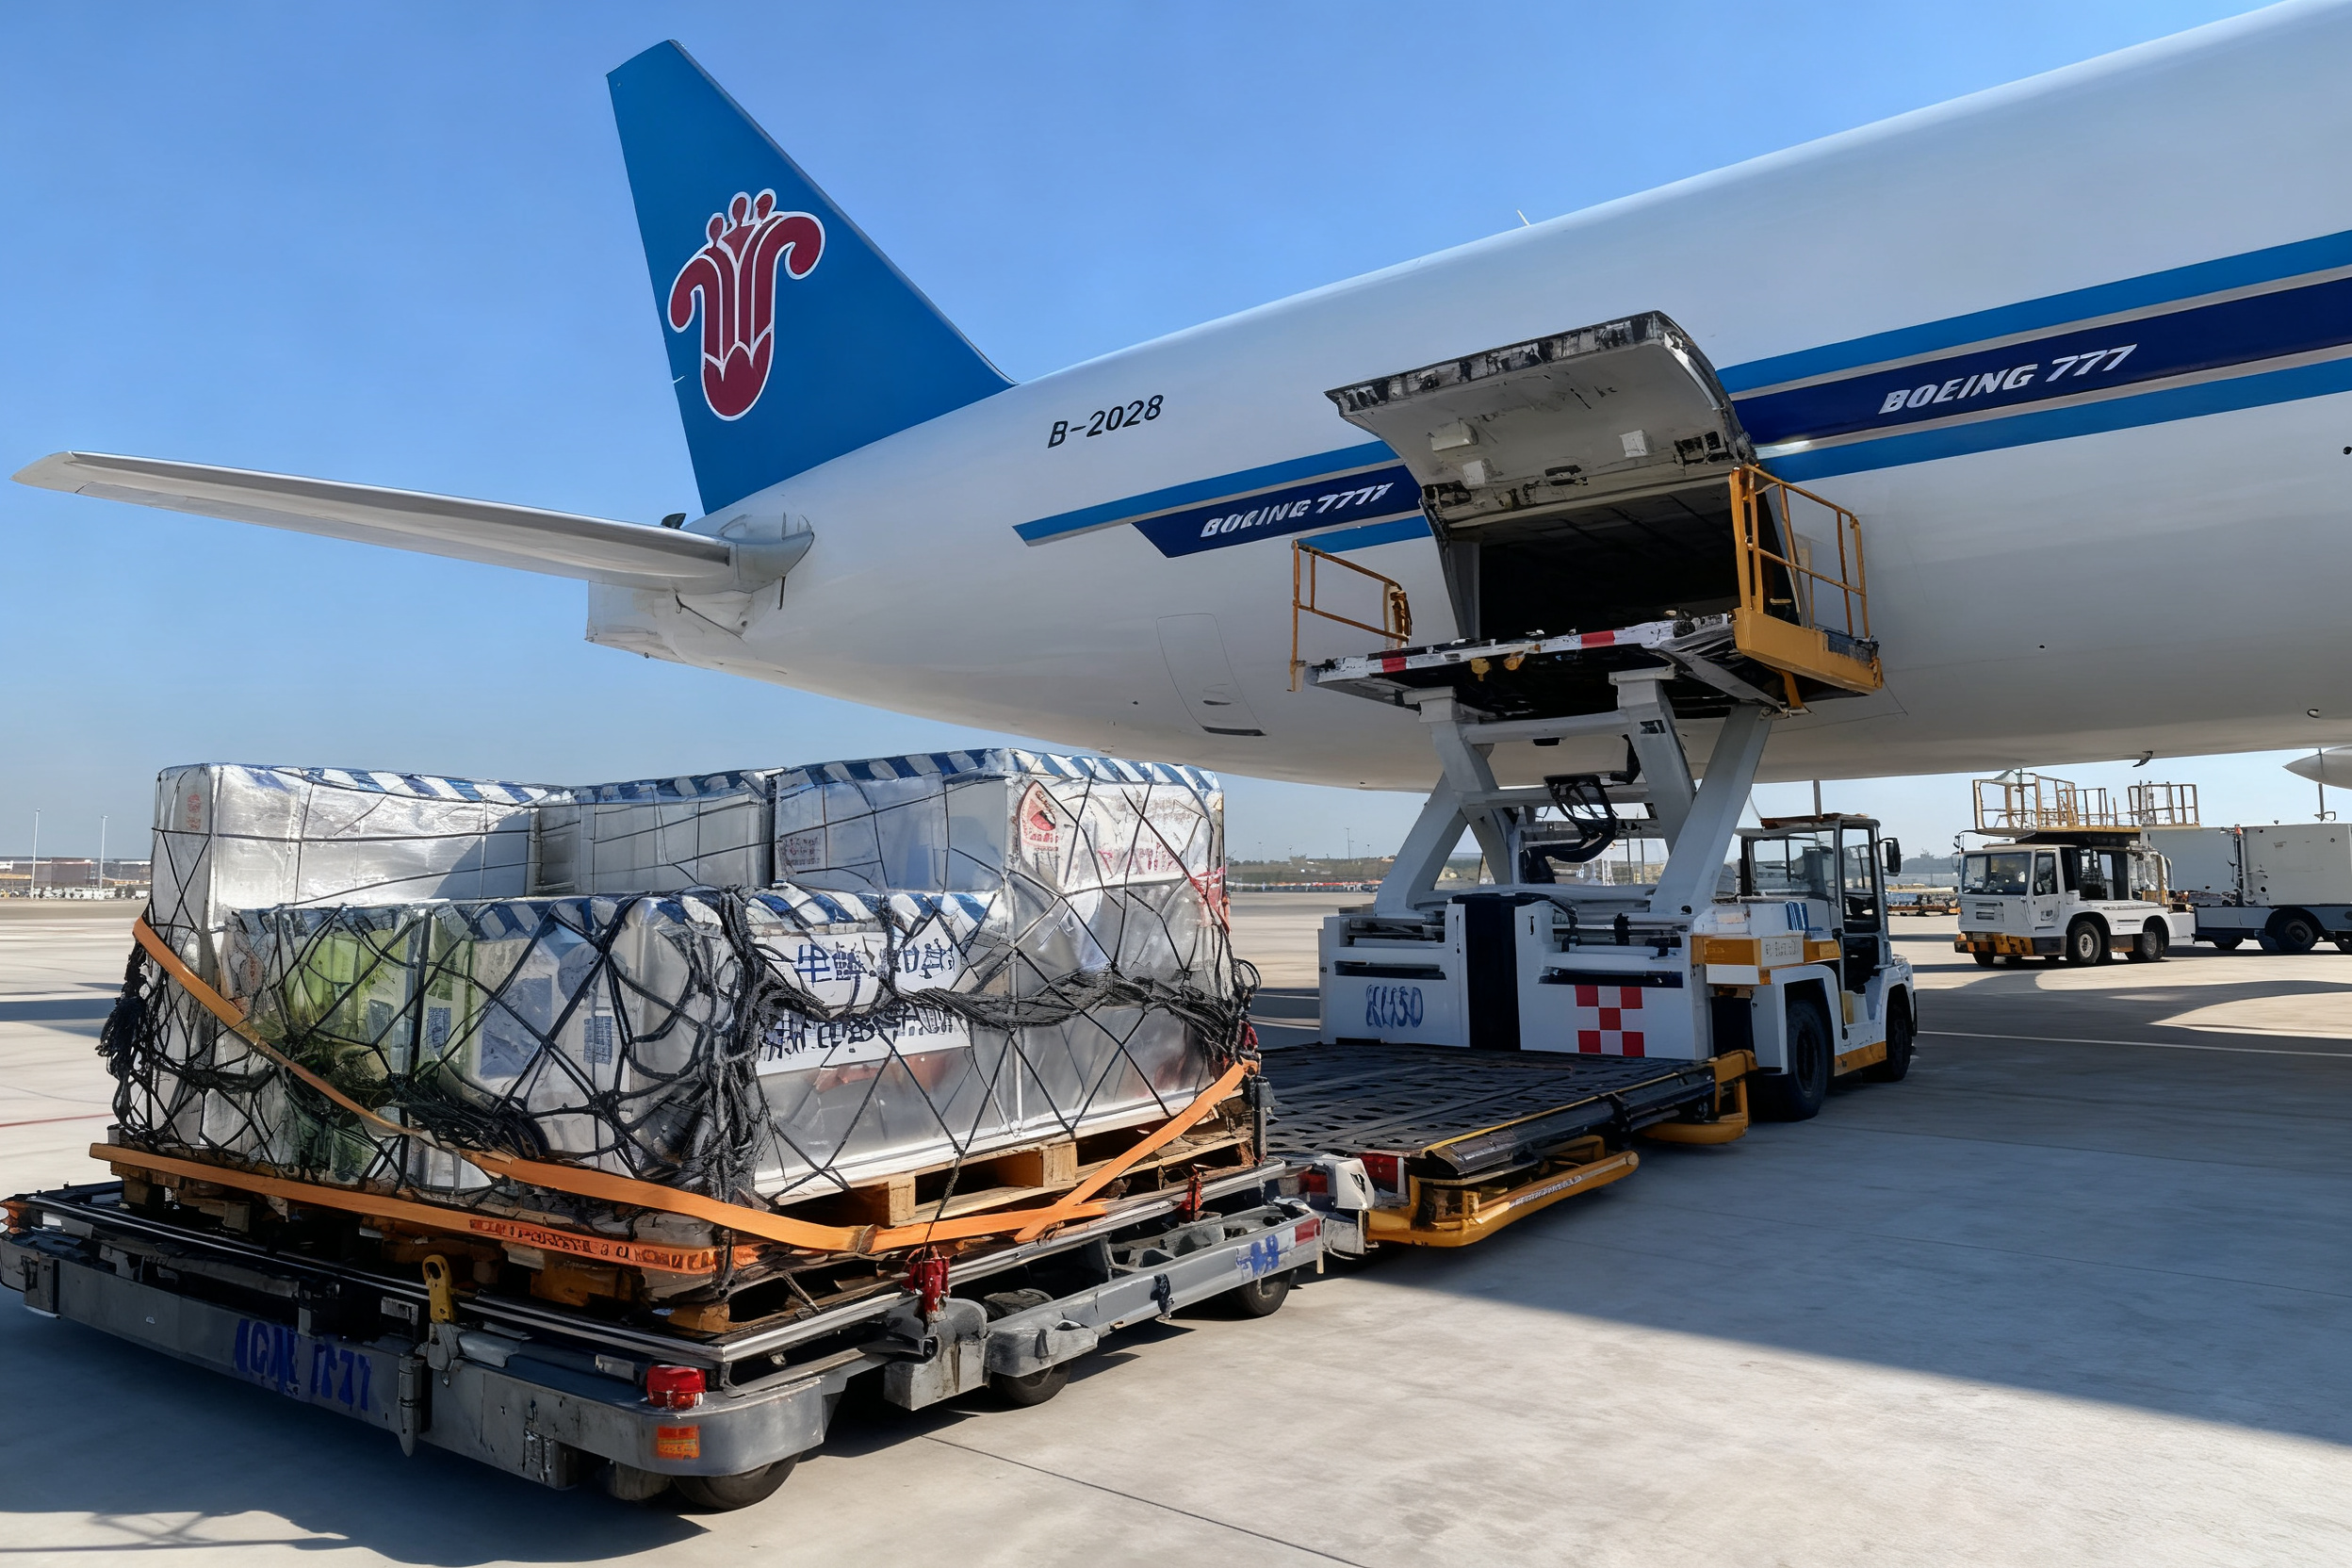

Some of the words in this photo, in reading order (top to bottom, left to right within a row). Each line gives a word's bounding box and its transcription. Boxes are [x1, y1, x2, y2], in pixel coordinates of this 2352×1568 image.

[1878, 364, 2038, 415] BOEING
[2046, 343, 2138, 383] 777
[1047, 394, 1164, 449] B-2028
